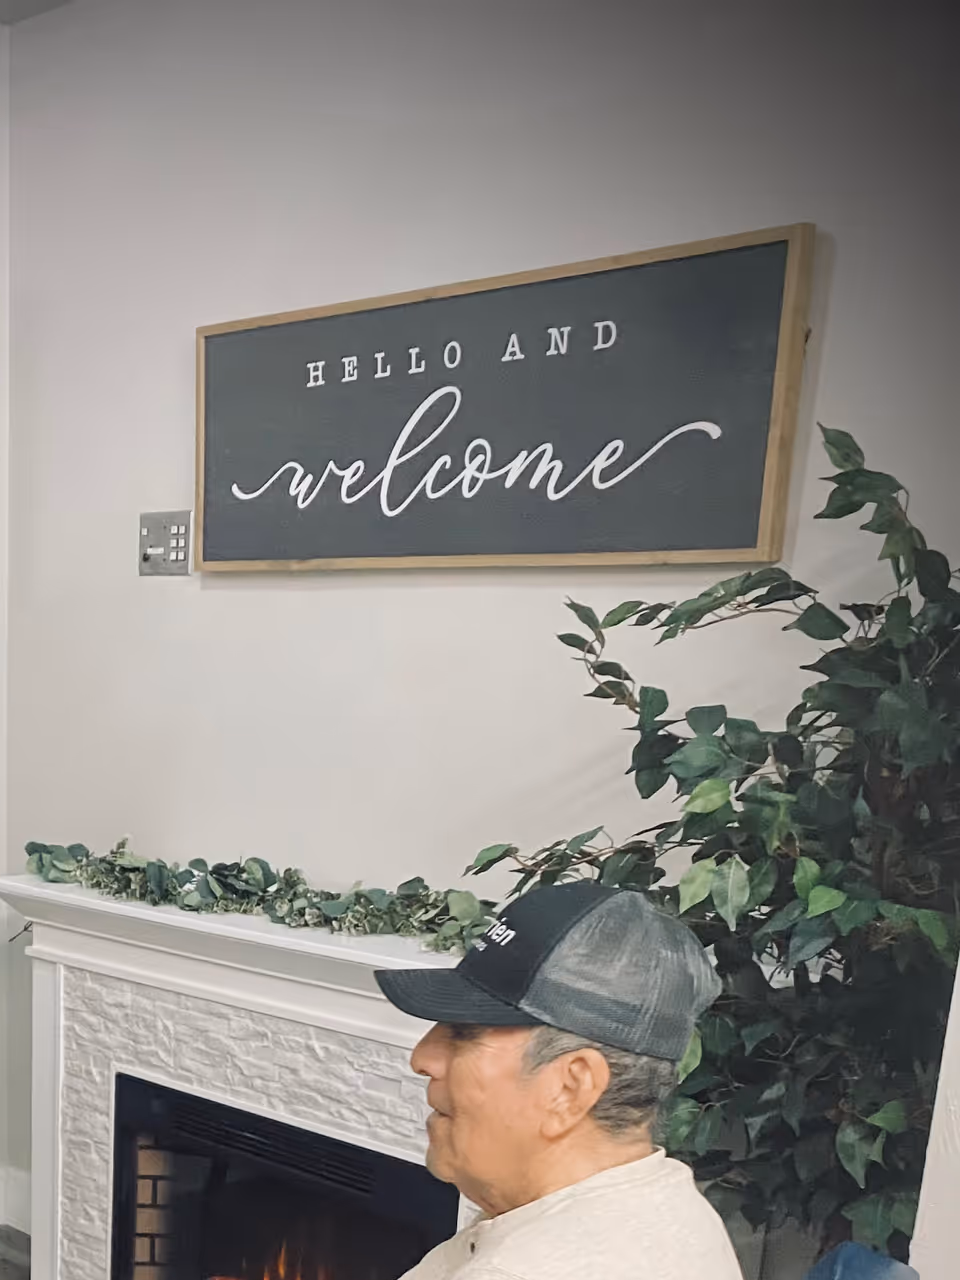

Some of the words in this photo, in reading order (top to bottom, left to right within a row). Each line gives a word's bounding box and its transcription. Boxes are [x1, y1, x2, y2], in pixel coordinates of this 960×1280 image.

[305, 340, 462, 389] HELLO
[501, 320, 619, 363] AND
[231, 385, 722, 518] welcome
